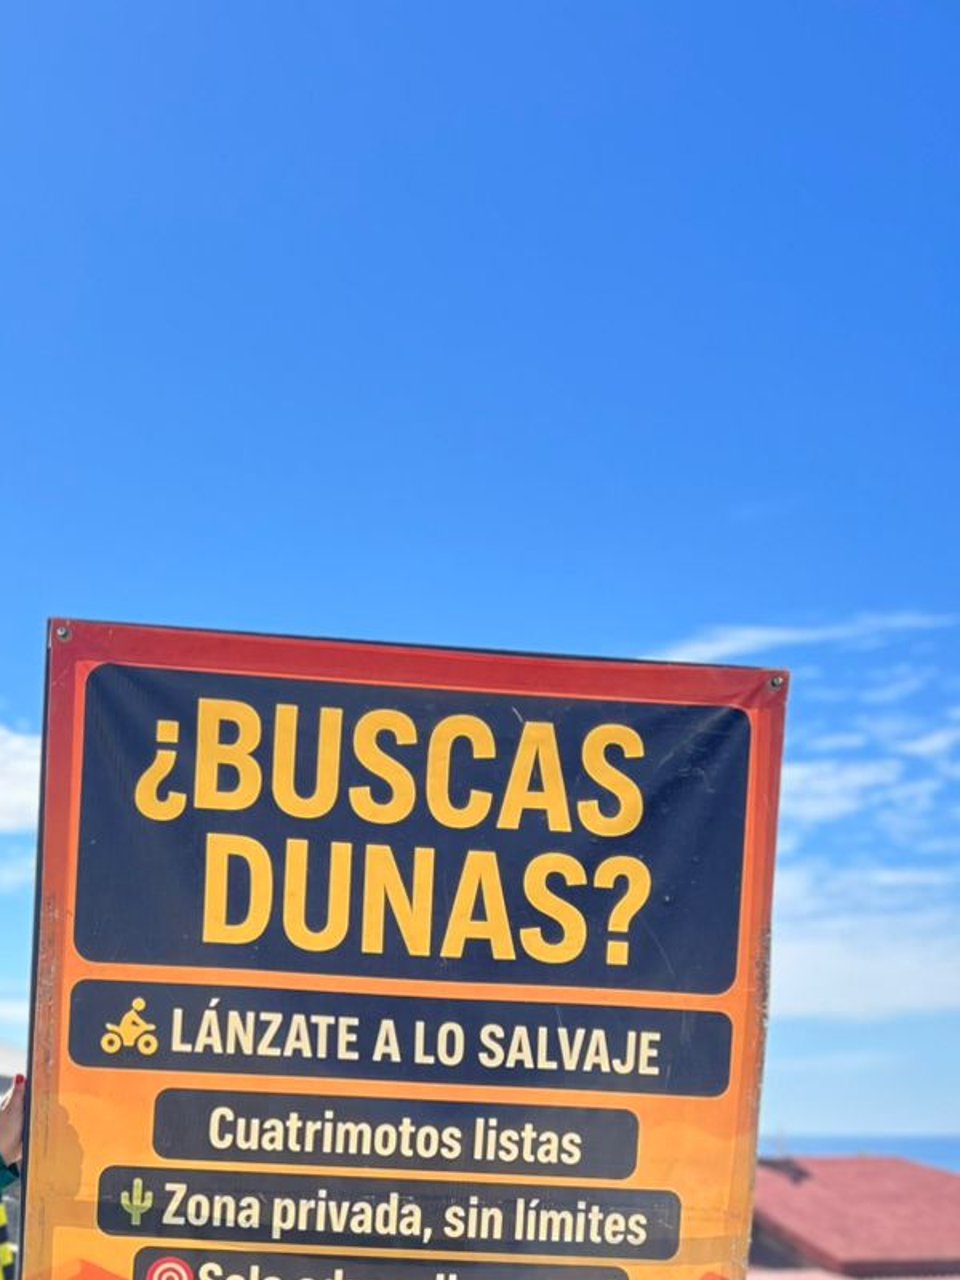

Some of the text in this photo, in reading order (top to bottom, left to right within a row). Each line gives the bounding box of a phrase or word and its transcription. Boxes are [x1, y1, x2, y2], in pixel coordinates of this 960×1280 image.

[134, 696, 646, 839] ¿BUSCAS
[201, 832, 653, 967] DUNAS?
[171, 997, 661, 1076] LÁNZATE A LO SALVAJE
[207, 1105, 582, 1165] Cuatrimotos listas
[162, 1182, 648, 1246] Zona privada, sin límites
